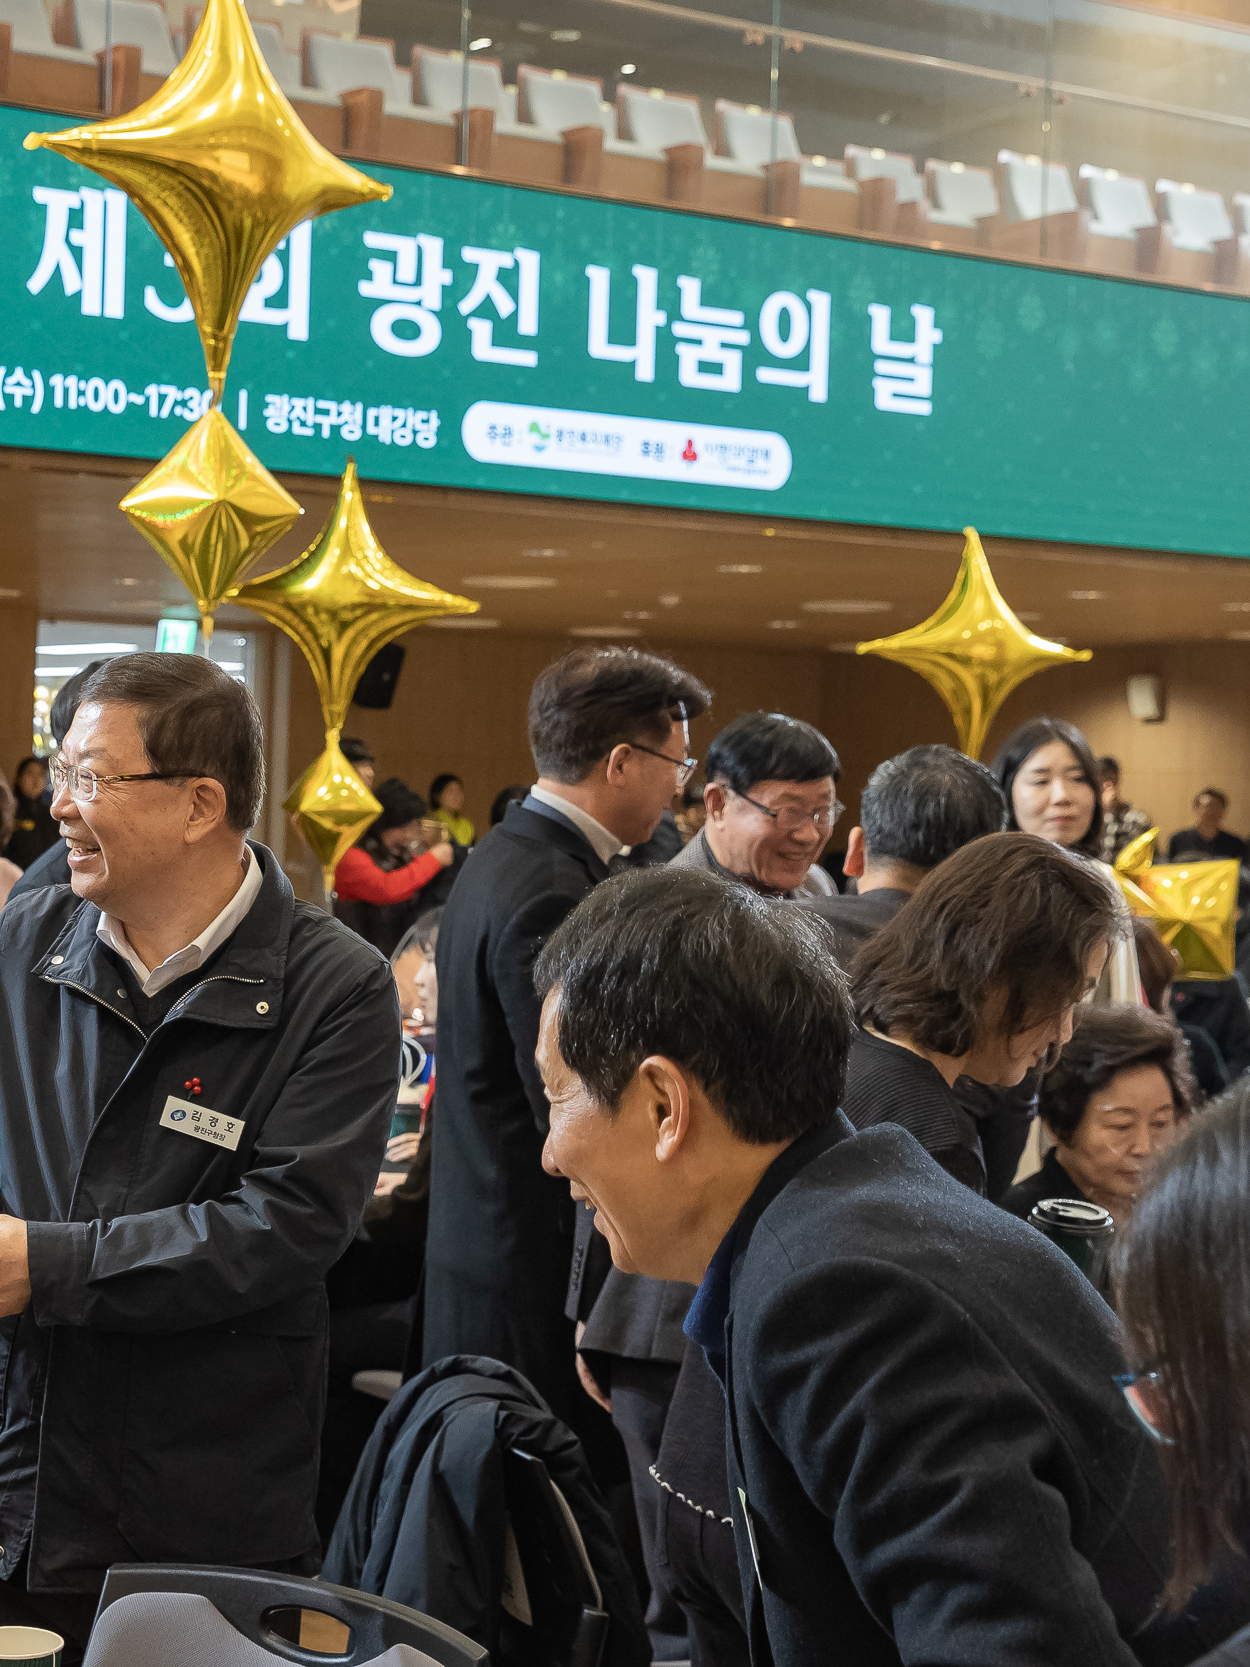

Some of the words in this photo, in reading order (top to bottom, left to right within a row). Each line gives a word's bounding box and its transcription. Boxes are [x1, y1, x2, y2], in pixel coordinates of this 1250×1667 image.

[358, 230, 541, 368] 광진
[585, 264, 831, 404] 나눔의
[867, 303, 944, 417] 날
[263, 394, 363, 441] 광진구청
[366, 405, 441, 450] 대강당
[193, 1124, 226, 1142] 광진구청장
